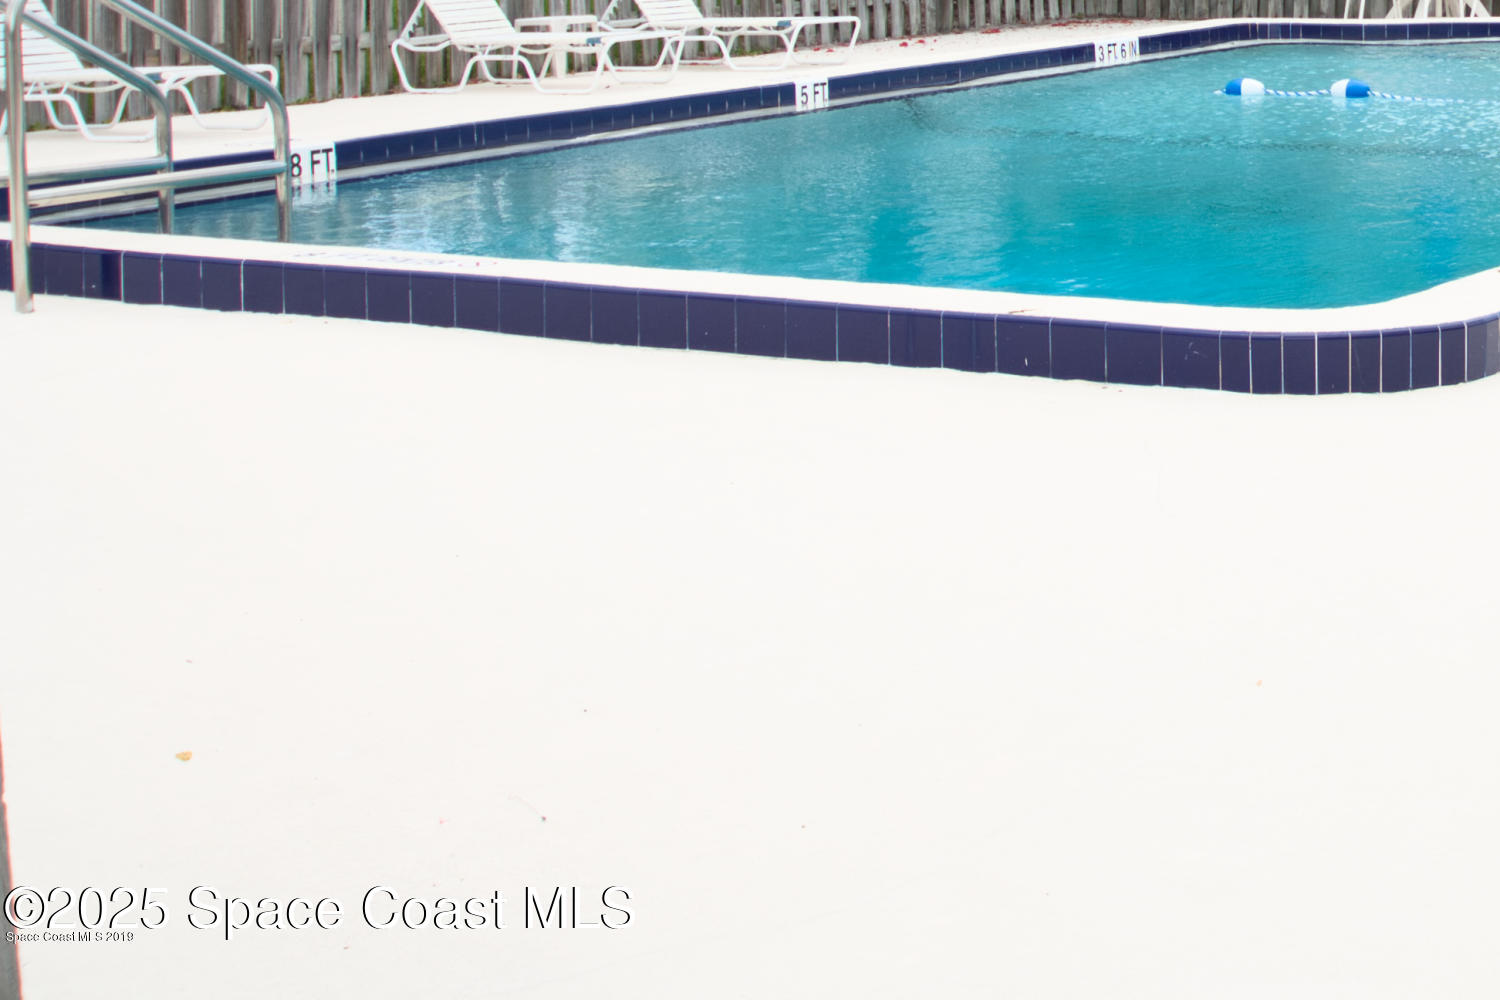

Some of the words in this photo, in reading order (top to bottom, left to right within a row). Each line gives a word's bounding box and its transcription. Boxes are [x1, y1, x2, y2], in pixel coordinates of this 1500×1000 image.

[1098, 45, 1104, 61] 3
[1121, 43, 1127, 59] 6
[1128, 40, 1137, 56] IN
[801, 85, 808, 105] 5
[291, 153, 302, 177] 8
